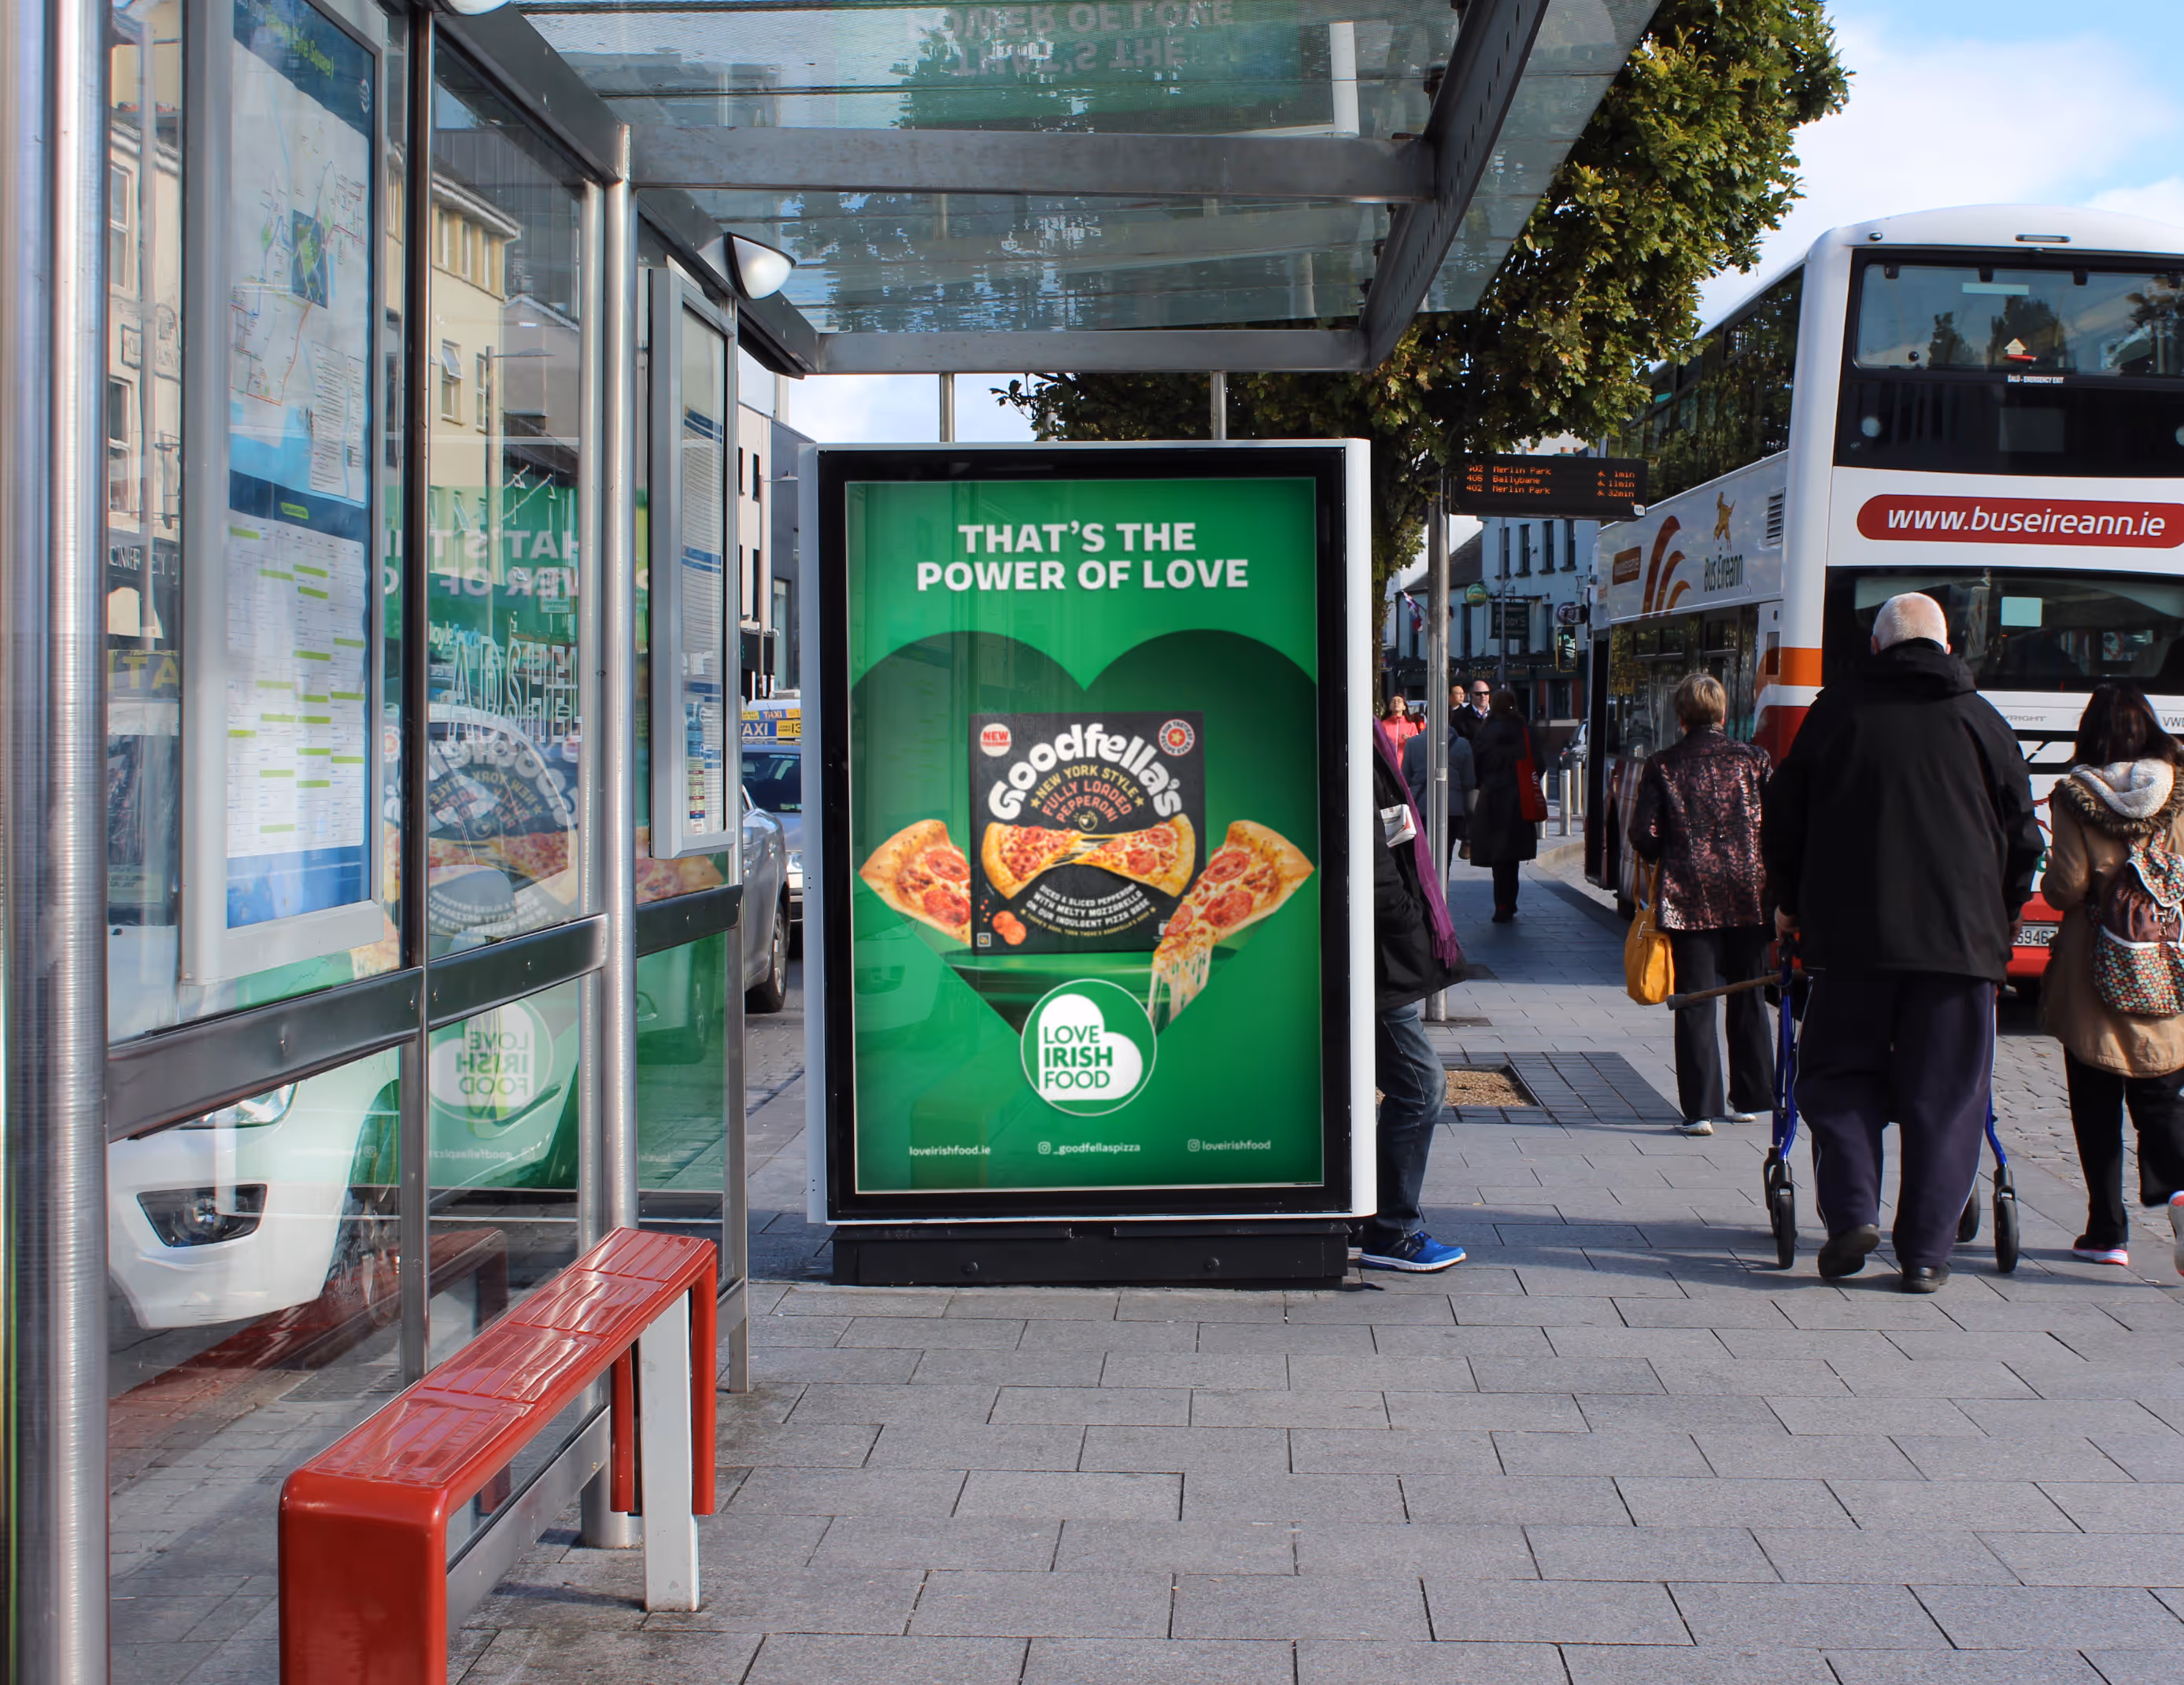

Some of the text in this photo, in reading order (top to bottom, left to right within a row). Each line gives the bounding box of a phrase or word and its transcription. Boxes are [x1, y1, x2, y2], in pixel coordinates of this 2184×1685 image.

[1493, 475, 1541, 485] Ballybane
[1888, 506, 2164, 536] www.buseireann.ie
[958, 520, 1196, 554] THAT'S THE
[917, 559, 1250, 592] POWER OF LOVE
[1704, 557, 1717, 592] Bus
[741, 722, 768, 736] AXI
[983, 731, 1008, 741] NEW
[989, 723, 1182, 820] Goodfella's
[1035, 764, 1140, 799] NEW YORK STYLE
[1041, 781, 1133, 816] FULLY LOADED
[1056, 795, 1118, 823] PEPPERONI
[1033, 890, 1144, 917] WITH MELTY MOZZARELLA
[1039, 884, 1060, 900] DICED
[1068, 898, 1096, 907] SLICED
[1097, 883, 1136, 907] PEPPERONI
[1026, 898, 1151, 928] ON OUR INDULGENT PIZZA BASE
[1044, 1025, 1100, 1044] LOVE
[1044, 1046, 1113, 1068] IRISH
[1045, 1070, 1110, 1089] FOOD
[909, 1145, 991, 1156] loveirishfood.ie
[1203, 1140, 1272, 1151] loveirishfood
